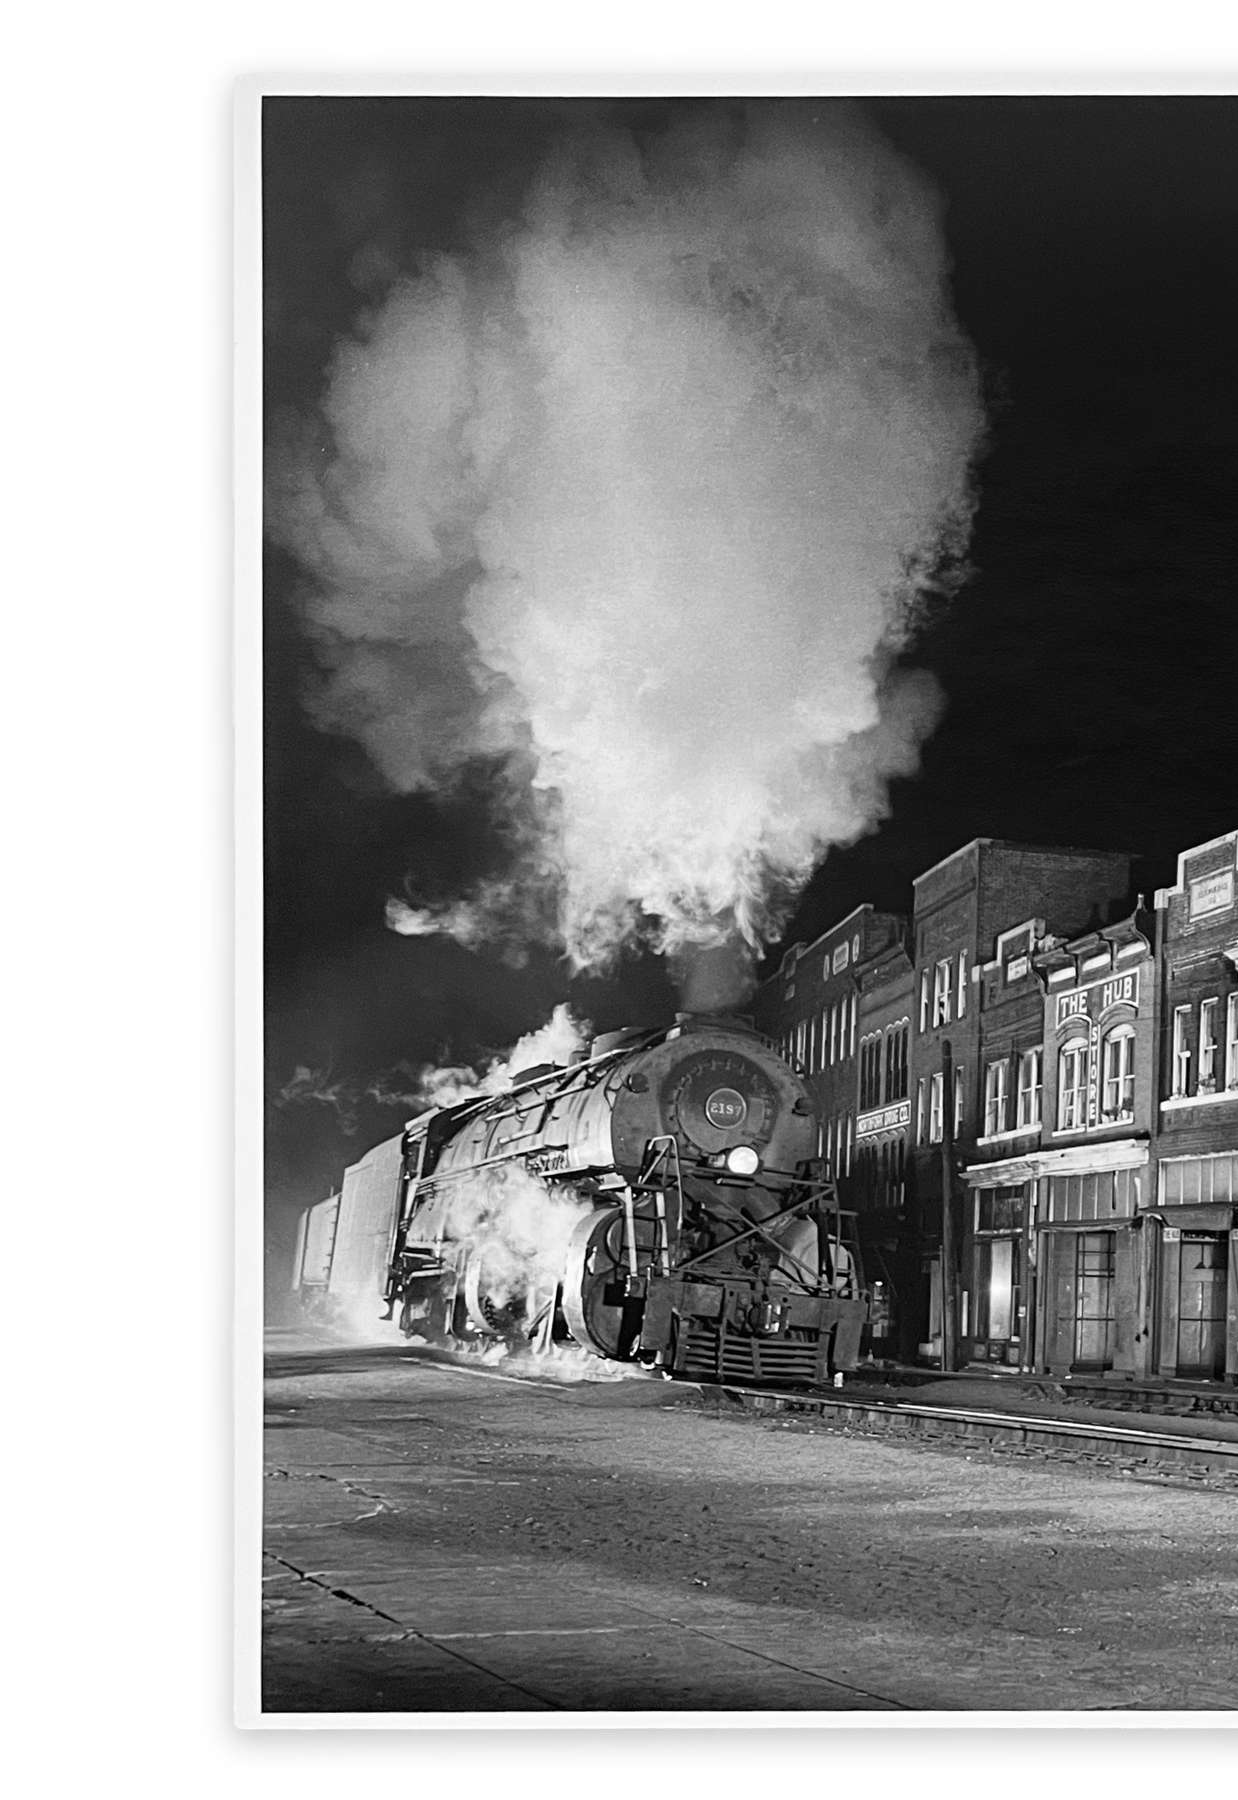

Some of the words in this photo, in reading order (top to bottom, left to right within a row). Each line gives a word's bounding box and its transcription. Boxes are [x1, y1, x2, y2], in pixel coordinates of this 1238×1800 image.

[1060, 991, 1088, 1018] THE
[1102, 976, 1132, 1009] HUB
[1089, 1026, 1098, 1120] STORE
